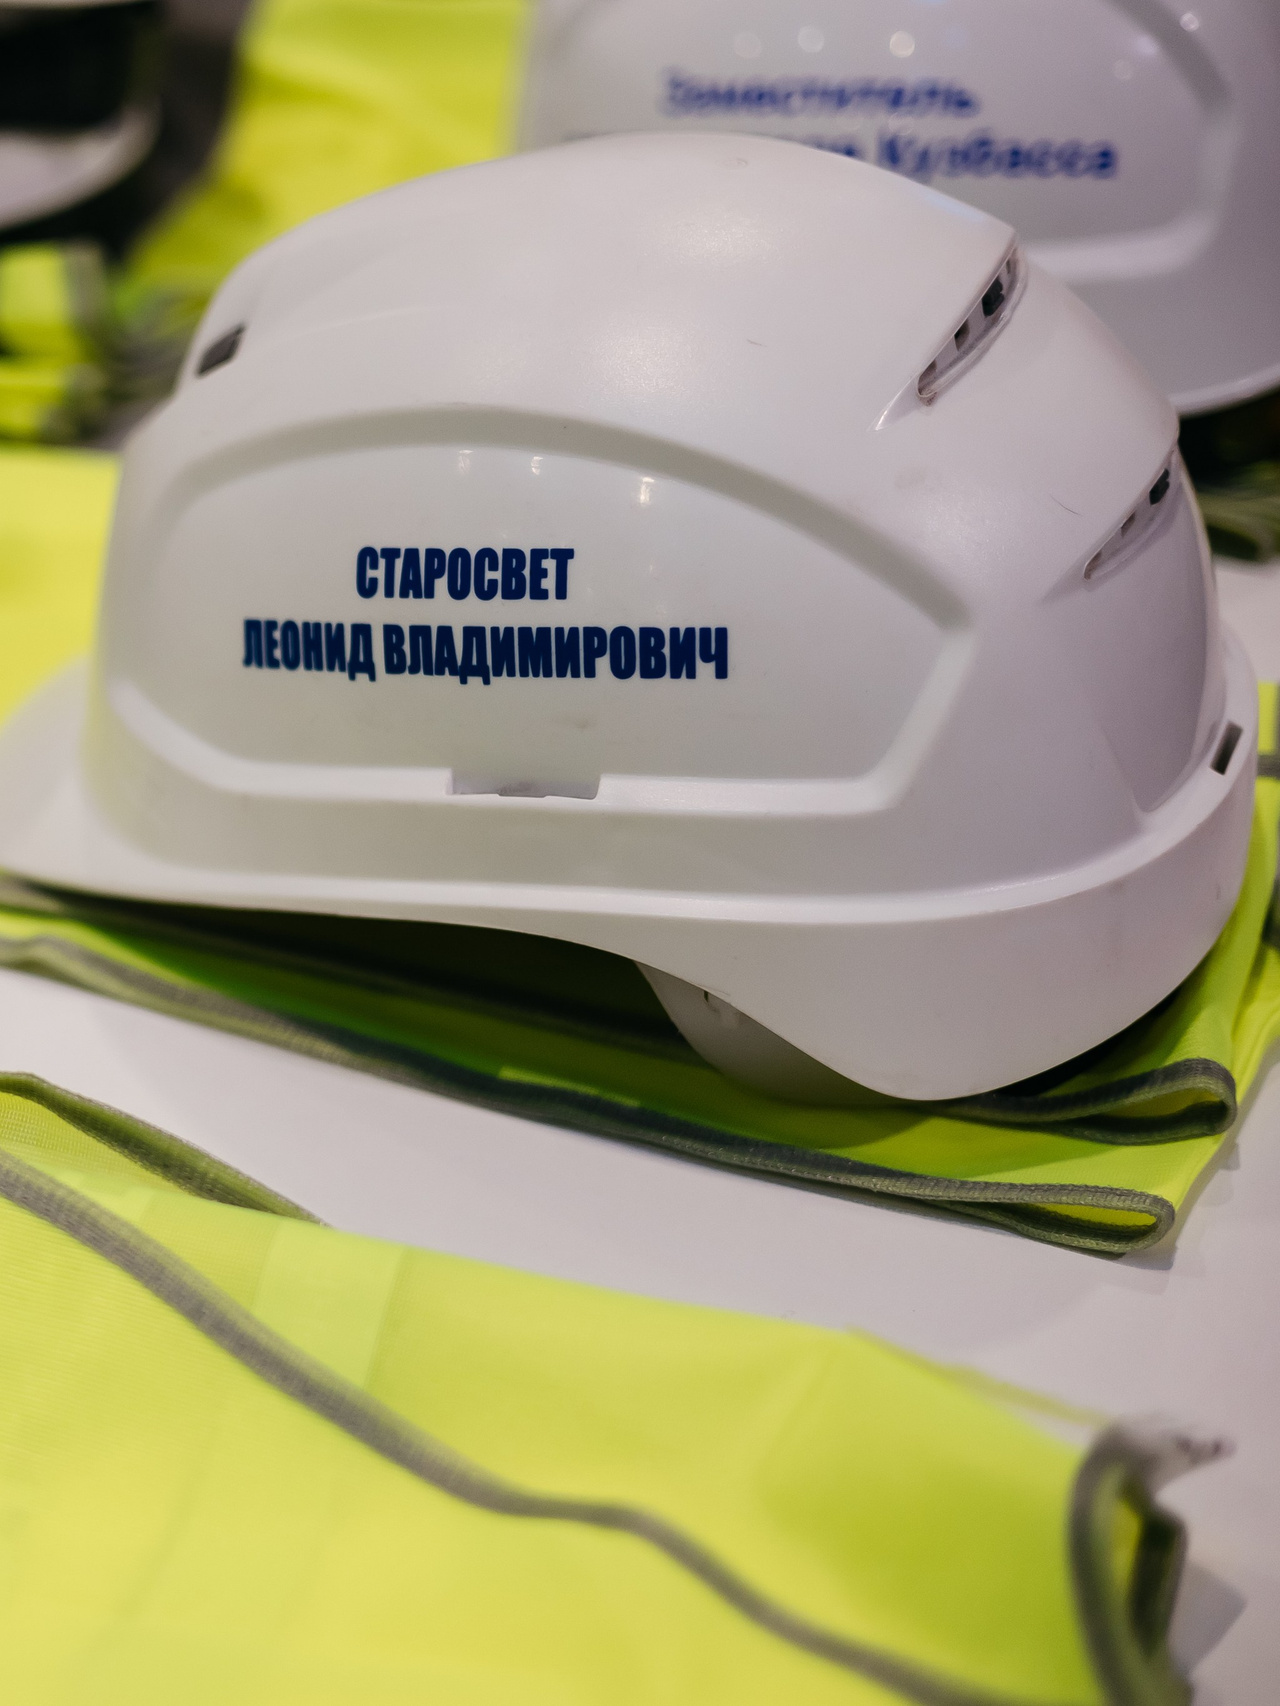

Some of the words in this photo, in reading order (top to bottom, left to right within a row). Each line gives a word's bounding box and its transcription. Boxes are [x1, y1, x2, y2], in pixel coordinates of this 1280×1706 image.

[356, 547, 575, 601] СТАРОСВЕТ
[243, 618, 377, 682] ЛЕОНИД
[382, 624, 729, 686] ВЛАДИМИРОВИЧ
